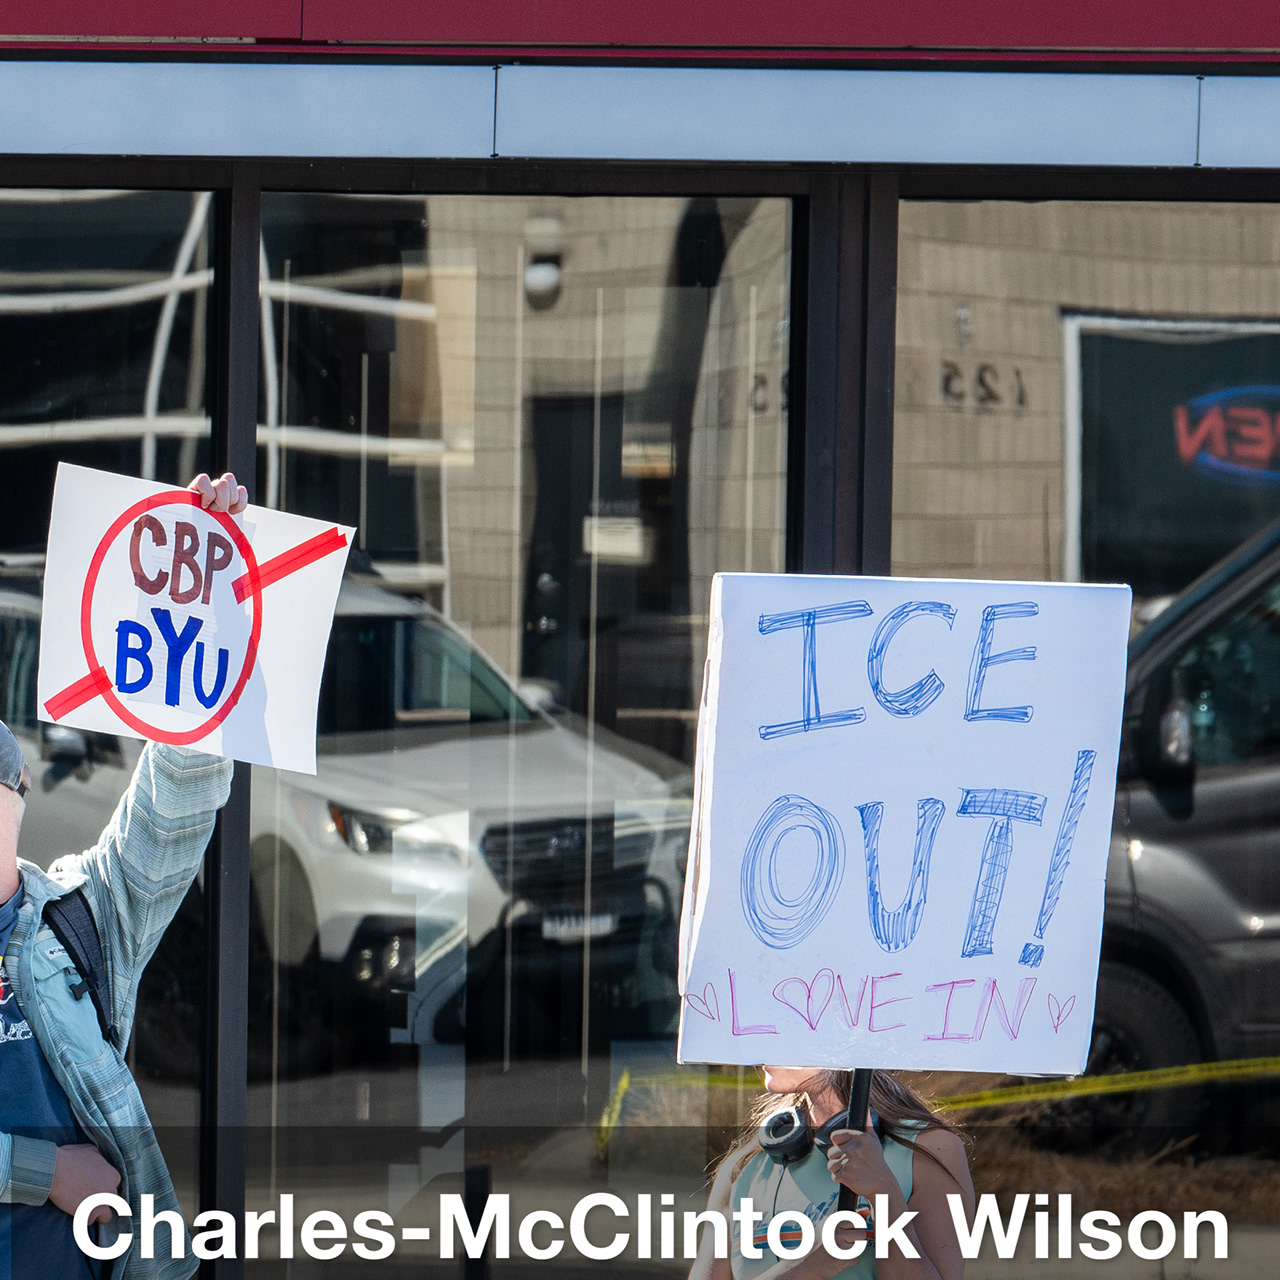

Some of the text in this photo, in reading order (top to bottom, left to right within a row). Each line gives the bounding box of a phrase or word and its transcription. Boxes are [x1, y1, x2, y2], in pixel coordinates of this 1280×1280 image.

[129, 514, 234, 605] CBP
[115, 608, 230, 710] BYU
[757, 599, 1040, 741] ICE
[741, 750, 1098, 969] OUT!
[923, 977, 1038, 1044] IN
